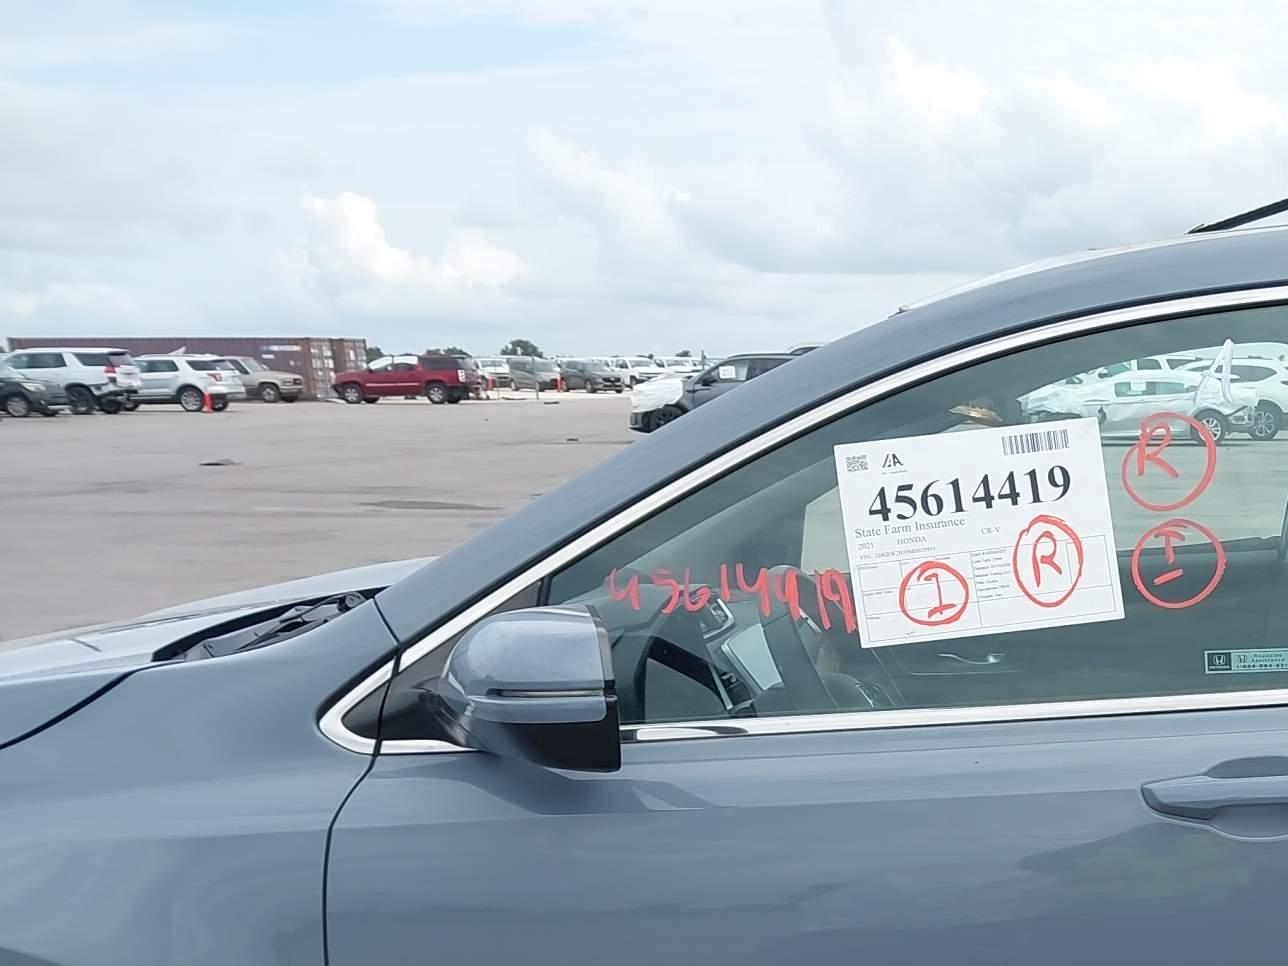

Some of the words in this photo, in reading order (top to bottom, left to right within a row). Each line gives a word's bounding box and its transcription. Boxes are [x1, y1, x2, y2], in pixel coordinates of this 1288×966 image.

[868, 464, 1071, 522] 45614419
[855, 526, 882, 539] State
[884, 523, 912, 535] Farm
[914, 517, 966, 531] Insurance
[858, 541, 874, 550] 2021
[896, 535, 928, 546] HONDA
[981, 526, 1001, 536] CR-V
